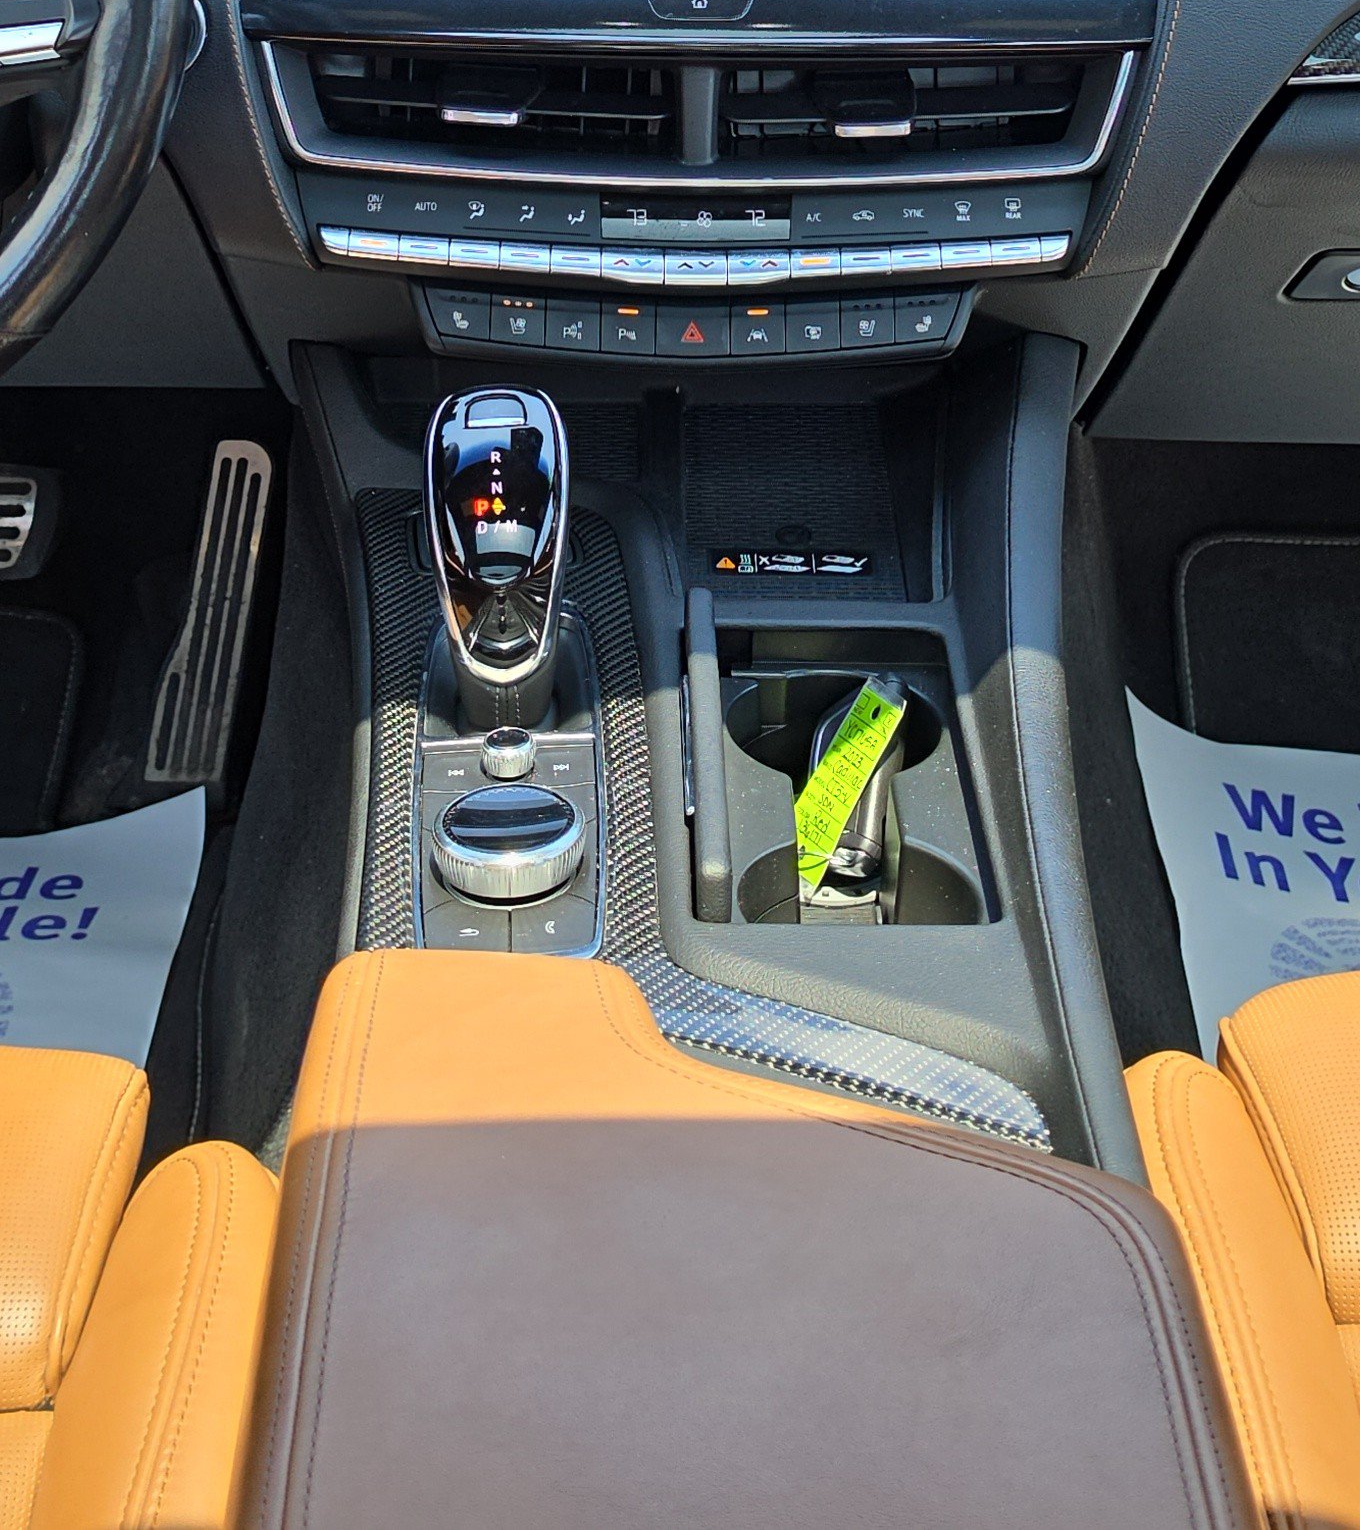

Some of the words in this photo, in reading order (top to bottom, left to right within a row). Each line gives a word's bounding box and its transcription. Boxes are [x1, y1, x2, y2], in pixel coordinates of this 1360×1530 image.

[367, 193, 384, 204] ON/
[367, 203, 383, 213] OFF
[414, 202, 437, 212] AUTO
[902, 207, 925, 219] SYNC
[744, 209, 766, 227] 72
[806, 212, 822, 223] A/C
[956, 214, 970, 222] MAX
[1004, 211, 1022, 220] REAR
[490, 451, 502, 464] R
[491, 481, 503, 495] N
[473, 498, 490, 517] P
[1222, 780, 1345, 847] We
[1214, 831, 1292, 894] In
